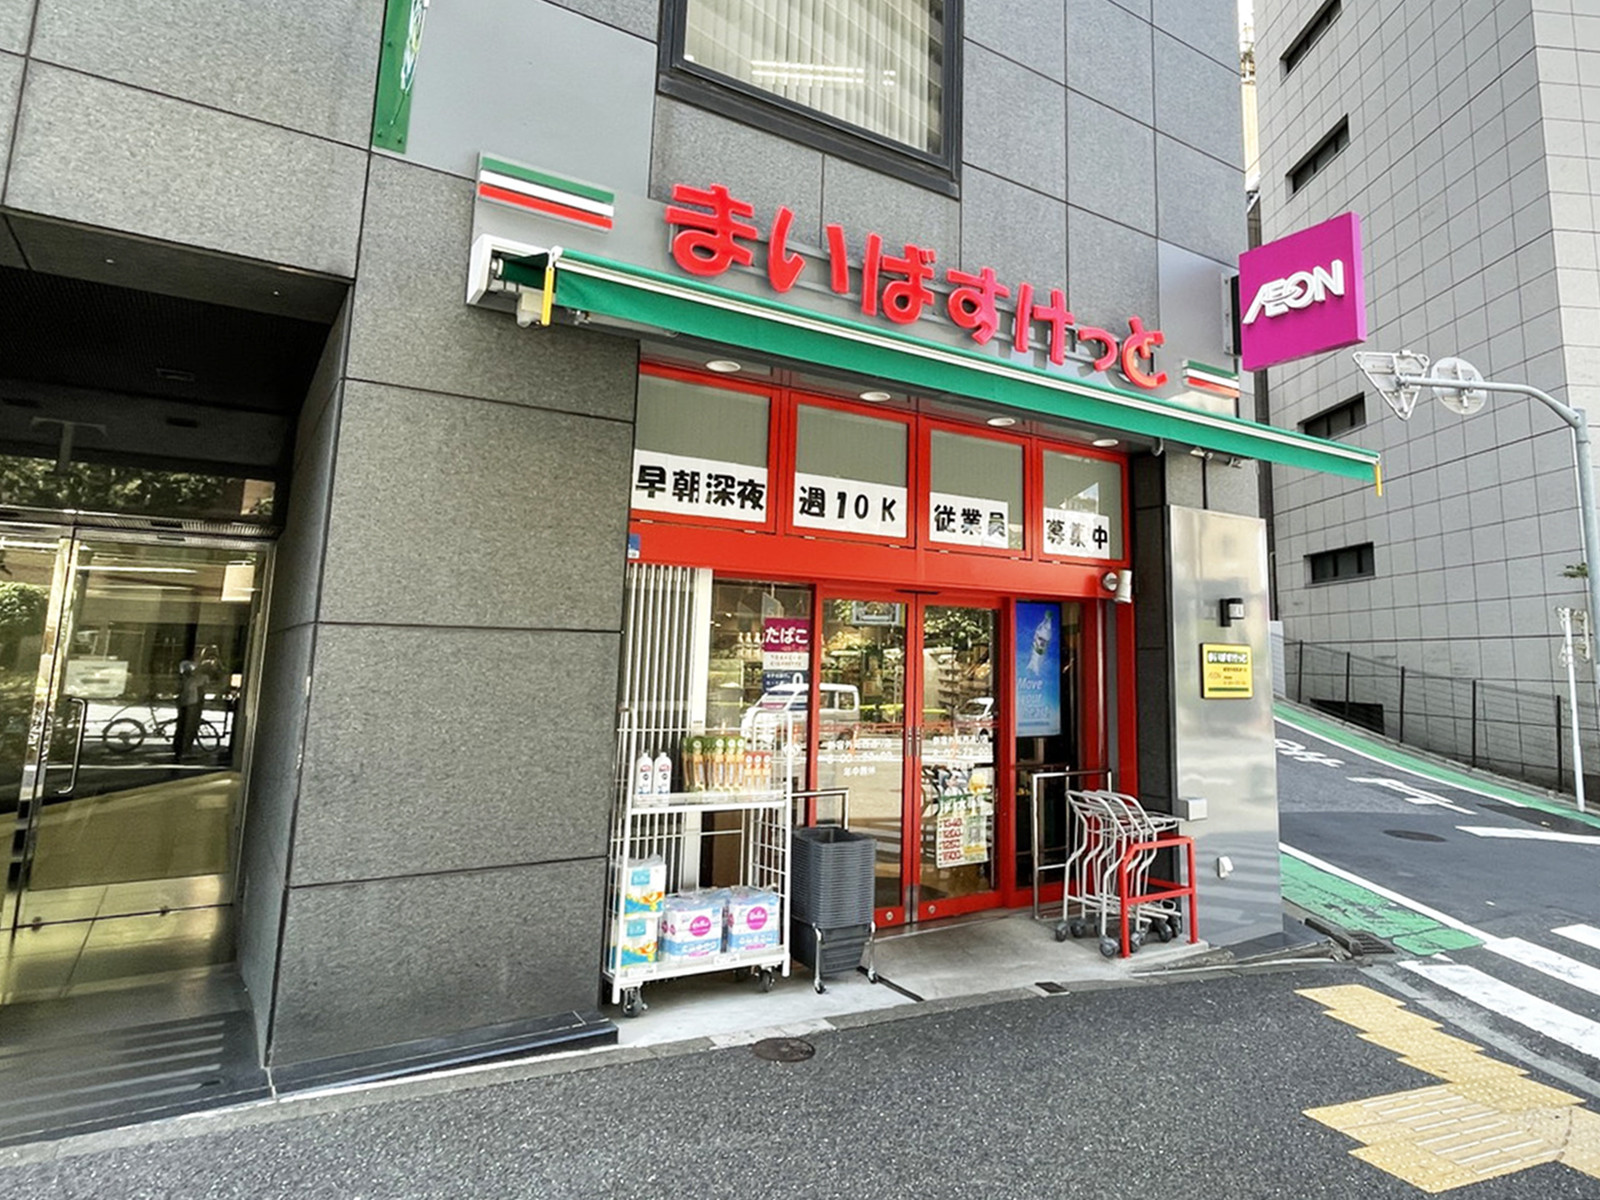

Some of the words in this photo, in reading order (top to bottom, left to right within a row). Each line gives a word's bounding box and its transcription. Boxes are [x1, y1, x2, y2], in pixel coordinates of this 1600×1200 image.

[664, 182, 1168, 390] まいばすけっと
[635, 464, 766, 511] 早朝深夜
[933, 504, 1006, 537] 従業員
[765, 626, 808, 644] たばこ
[1018, 677, 1043, 690] Move
